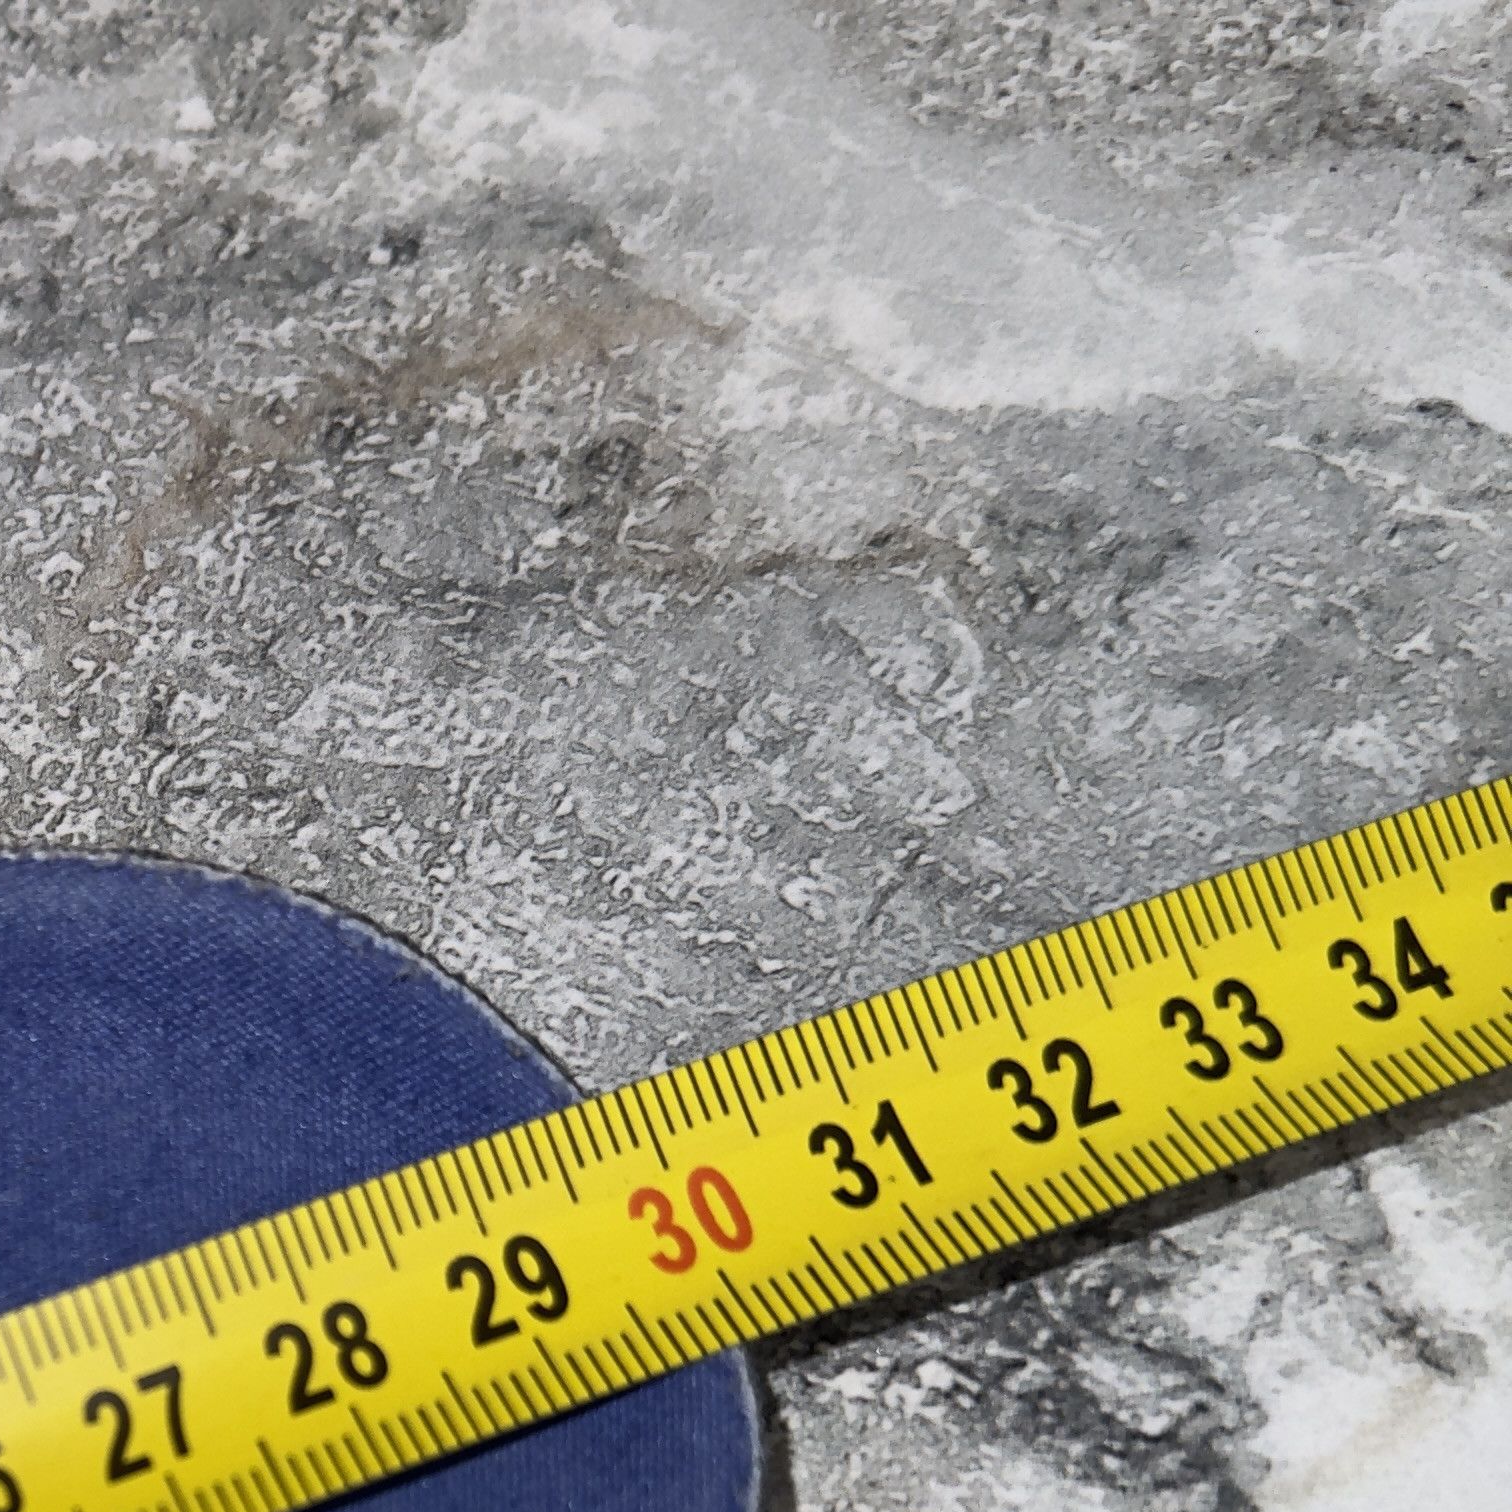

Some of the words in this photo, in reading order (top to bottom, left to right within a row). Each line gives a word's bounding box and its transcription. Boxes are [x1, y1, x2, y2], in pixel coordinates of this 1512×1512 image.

[84, 1365, 191, 1484] 27
[264, 1301, 390, 1416] 28
[445, 1235, 571, 1348] 29
[628, 1165, 755, 1274] 30
[808, 1099, 934, 1210] 31
[986, 1037, 1123, 1145] 32
[1159, 977, 1286, 1082] 33
[1326, 916, 1455, 1022] 34
